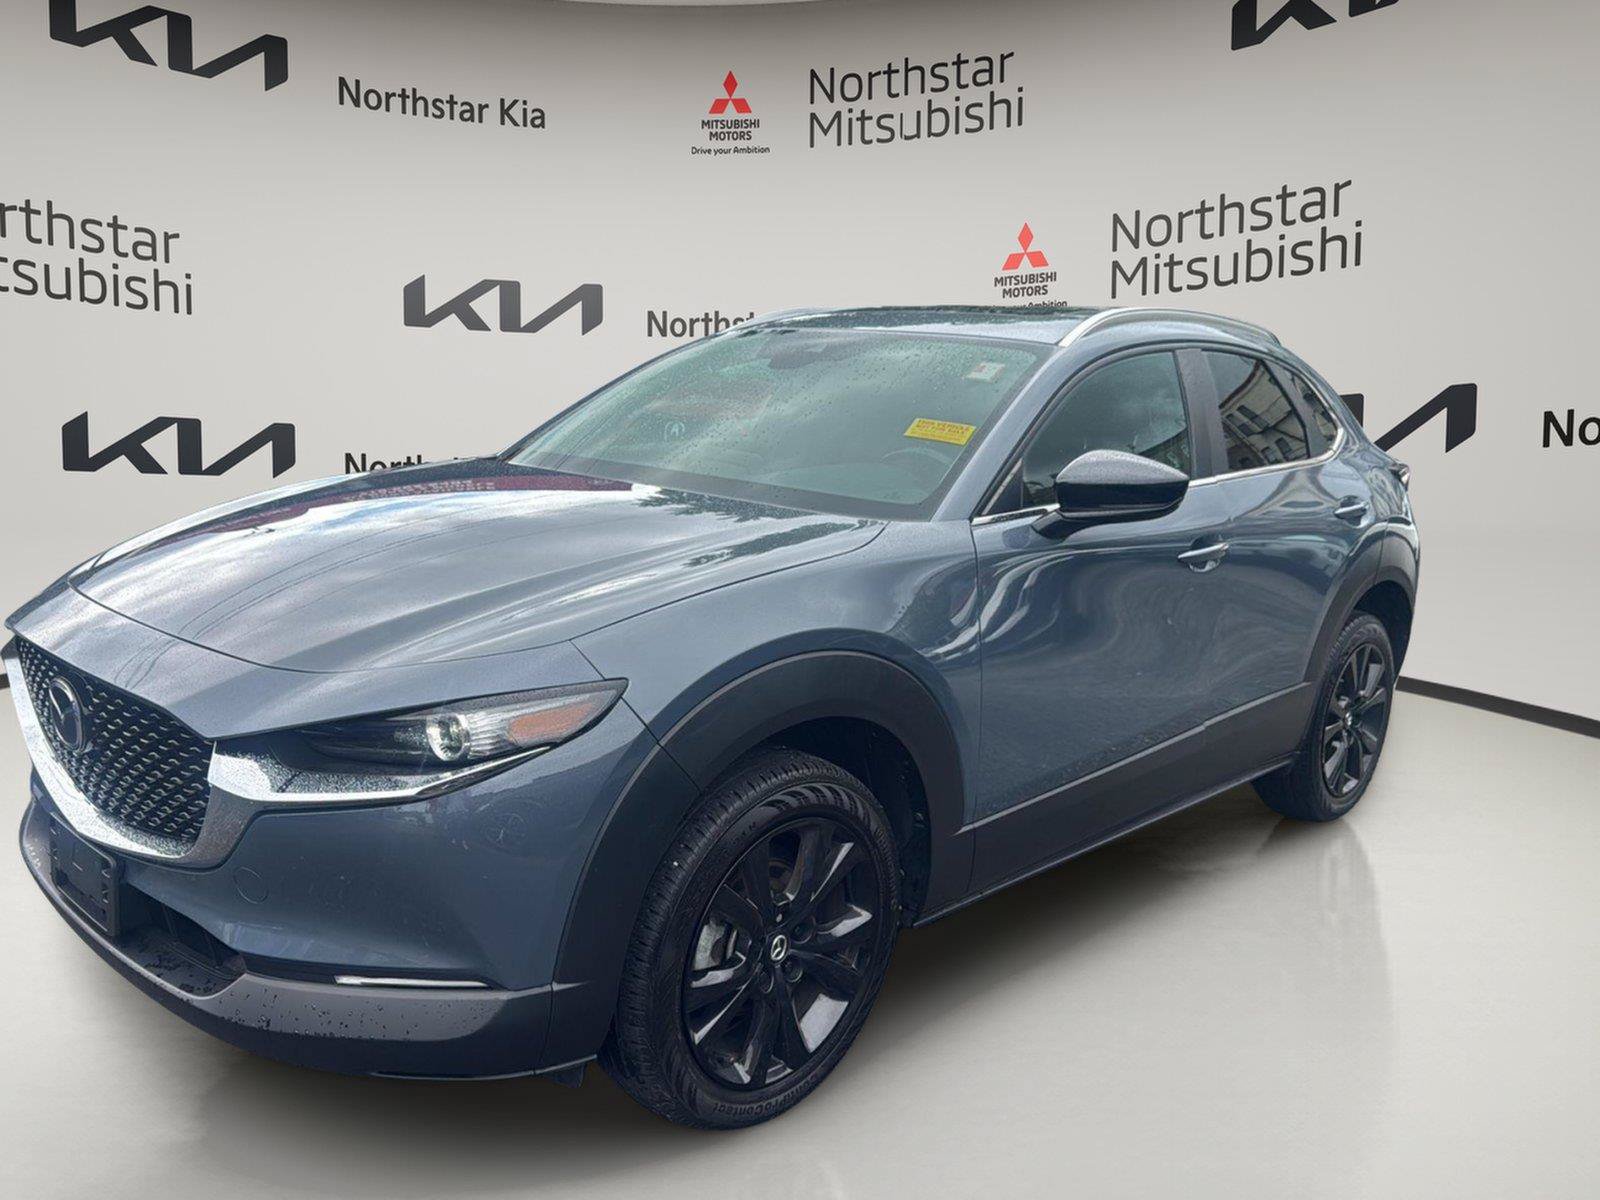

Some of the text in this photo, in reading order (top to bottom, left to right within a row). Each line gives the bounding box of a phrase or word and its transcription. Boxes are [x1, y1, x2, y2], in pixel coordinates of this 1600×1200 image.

[338, 76, 546, 129] Northstar Kia
[809, 51, 1014, 104] Northstar
[701, 119, 760, 130] MITSUBISHI
[709, 131, 752, 141] MOTORS
[809, 88, 1024, 148] Mitsubishi
[691, 146, 771, 156] Drive your Ambition
[0, 199, 180, 263] rthstar
[1111, 180, 1352, 252] Northstar
[0, 256, 192, 315] subishi
[993, 271, 1057, 287] MITSUBISHI
[1110, 220, 1363, 299] Mitsubishi
[1003, 285, 1048, 298] MOTORS
[647, 310, 754, 337] North
